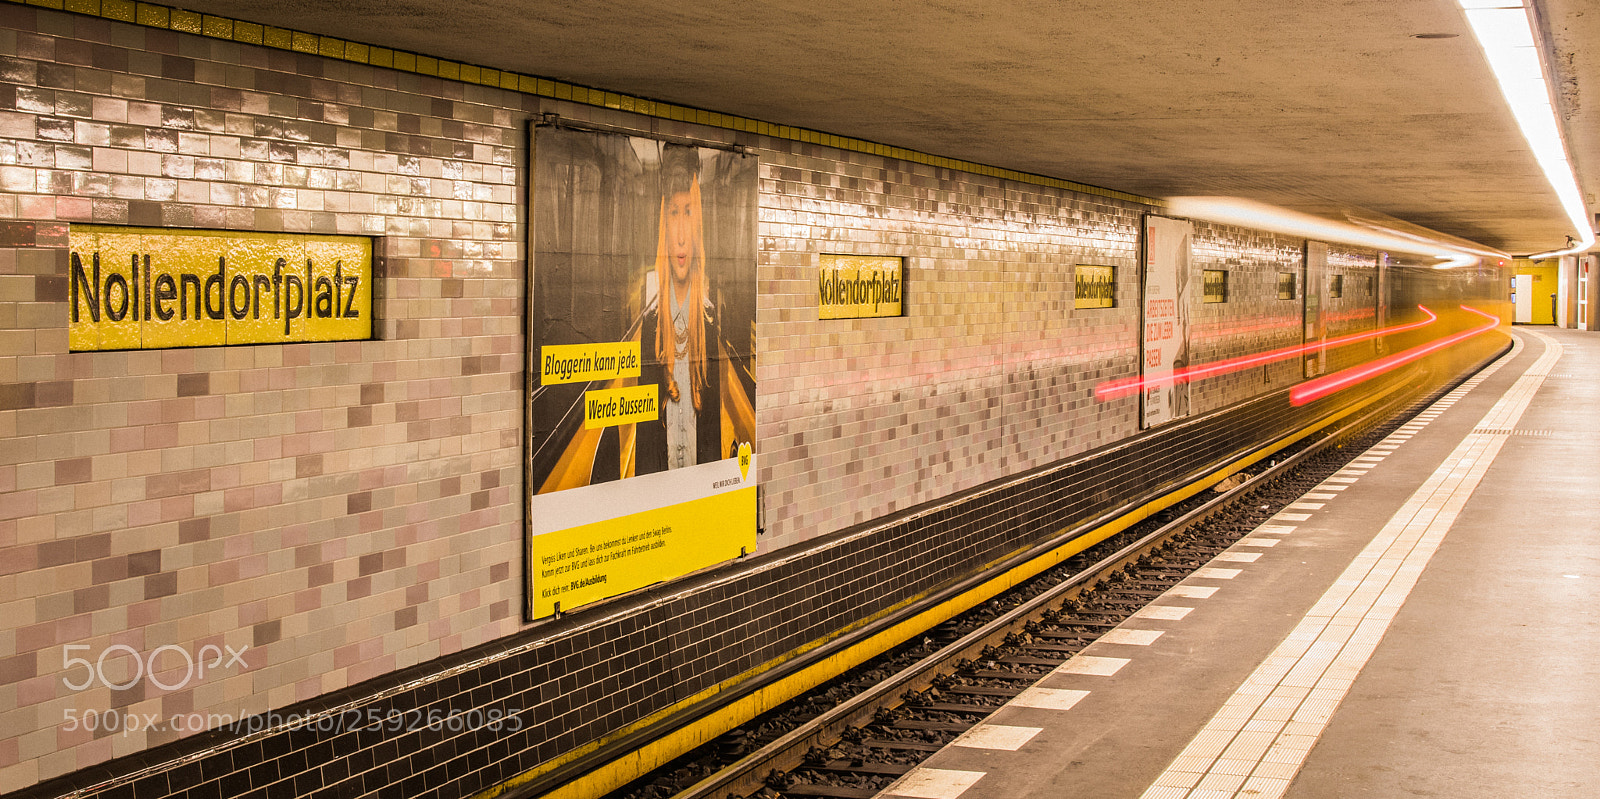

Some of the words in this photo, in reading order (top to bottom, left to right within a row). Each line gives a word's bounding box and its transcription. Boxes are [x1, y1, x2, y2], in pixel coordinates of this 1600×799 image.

[71, 252, 360, 335] Nollendorfplatz
[544, 353, 591, 380] Bloggerin
[593, 351, 615, 371] kann
[617, 349, 638, 375] jede.
[588, 397, 617, 420] Werde
[619, 393, 656, 416] Busserin.
[741, 455, 749, 466] BVG
[542, 554, 556, 566] Vergiss
[557, 551, 566, 561] Liken
[542, 569, 554, 578] Komm
[555, 566, 564, 577] jetzt
[572, 560, 580, 570] BVG
[542, 588, 551, 598] Klick
[552, 585, 560, 596] dich
[571, 574, 607, 591] BVG.de/Ausbildung
